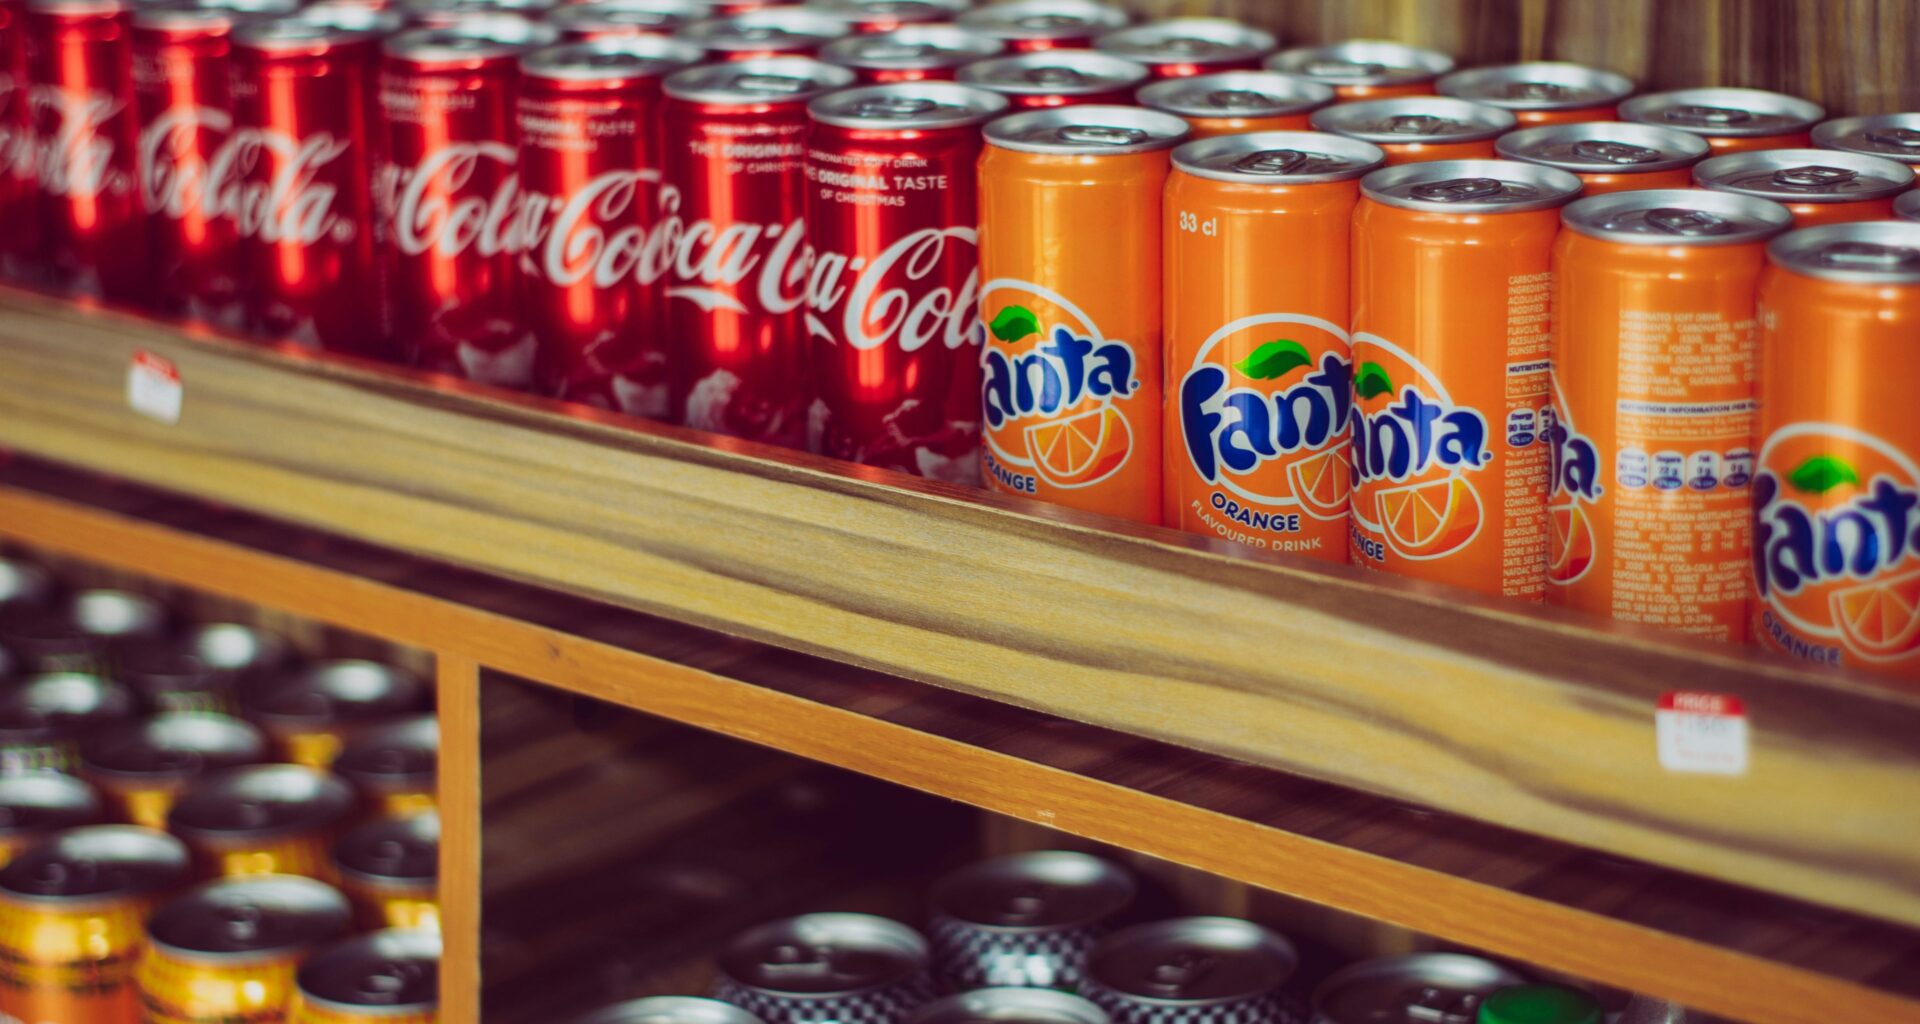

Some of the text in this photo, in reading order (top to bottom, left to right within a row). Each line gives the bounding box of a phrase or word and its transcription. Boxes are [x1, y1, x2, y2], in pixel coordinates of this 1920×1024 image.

[818, 169, 889, 191] ORIGINAL
[893, 175, 949, 191] TASTE
[864, 155, 892, 169] SOFT
[893, 158, 928, 170] DRINK
[820, 189, 906, 207] OF CHRISTMAS
[1179, 210, 1217, 237] 33 cl
[978, 324, 1133, 429] anta
[1508, 362, 1550, 373] NUTRITION
[1191, 500, 1322, 552] FLAVOURED DRINK
[1211, 491, 1300, 533] ORANGE
[1351, 526, 1384, 562] ANGE
[1753, 472, 1920, 598] Fant
[1762, 610, 1841, 666] ORANGE
